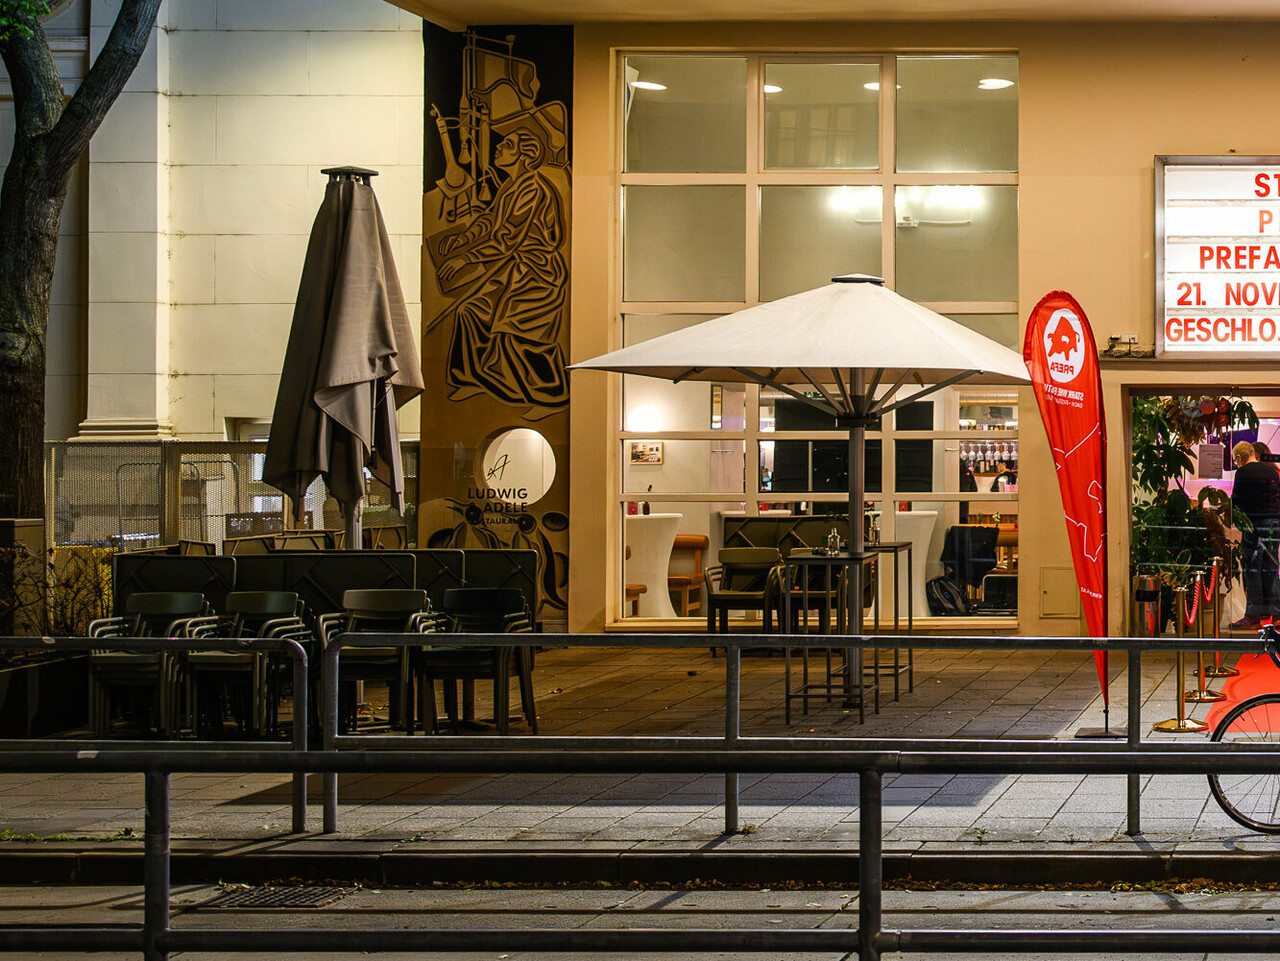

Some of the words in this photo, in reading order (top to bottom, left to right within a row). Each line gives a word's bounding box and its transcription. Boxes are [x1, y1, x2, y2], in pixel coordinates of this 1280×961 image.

[1176, 281, 1207, 306] 21.
[468, 488, 528, 499] LUDWIG
[483, 502, 528, 513] ADELE
